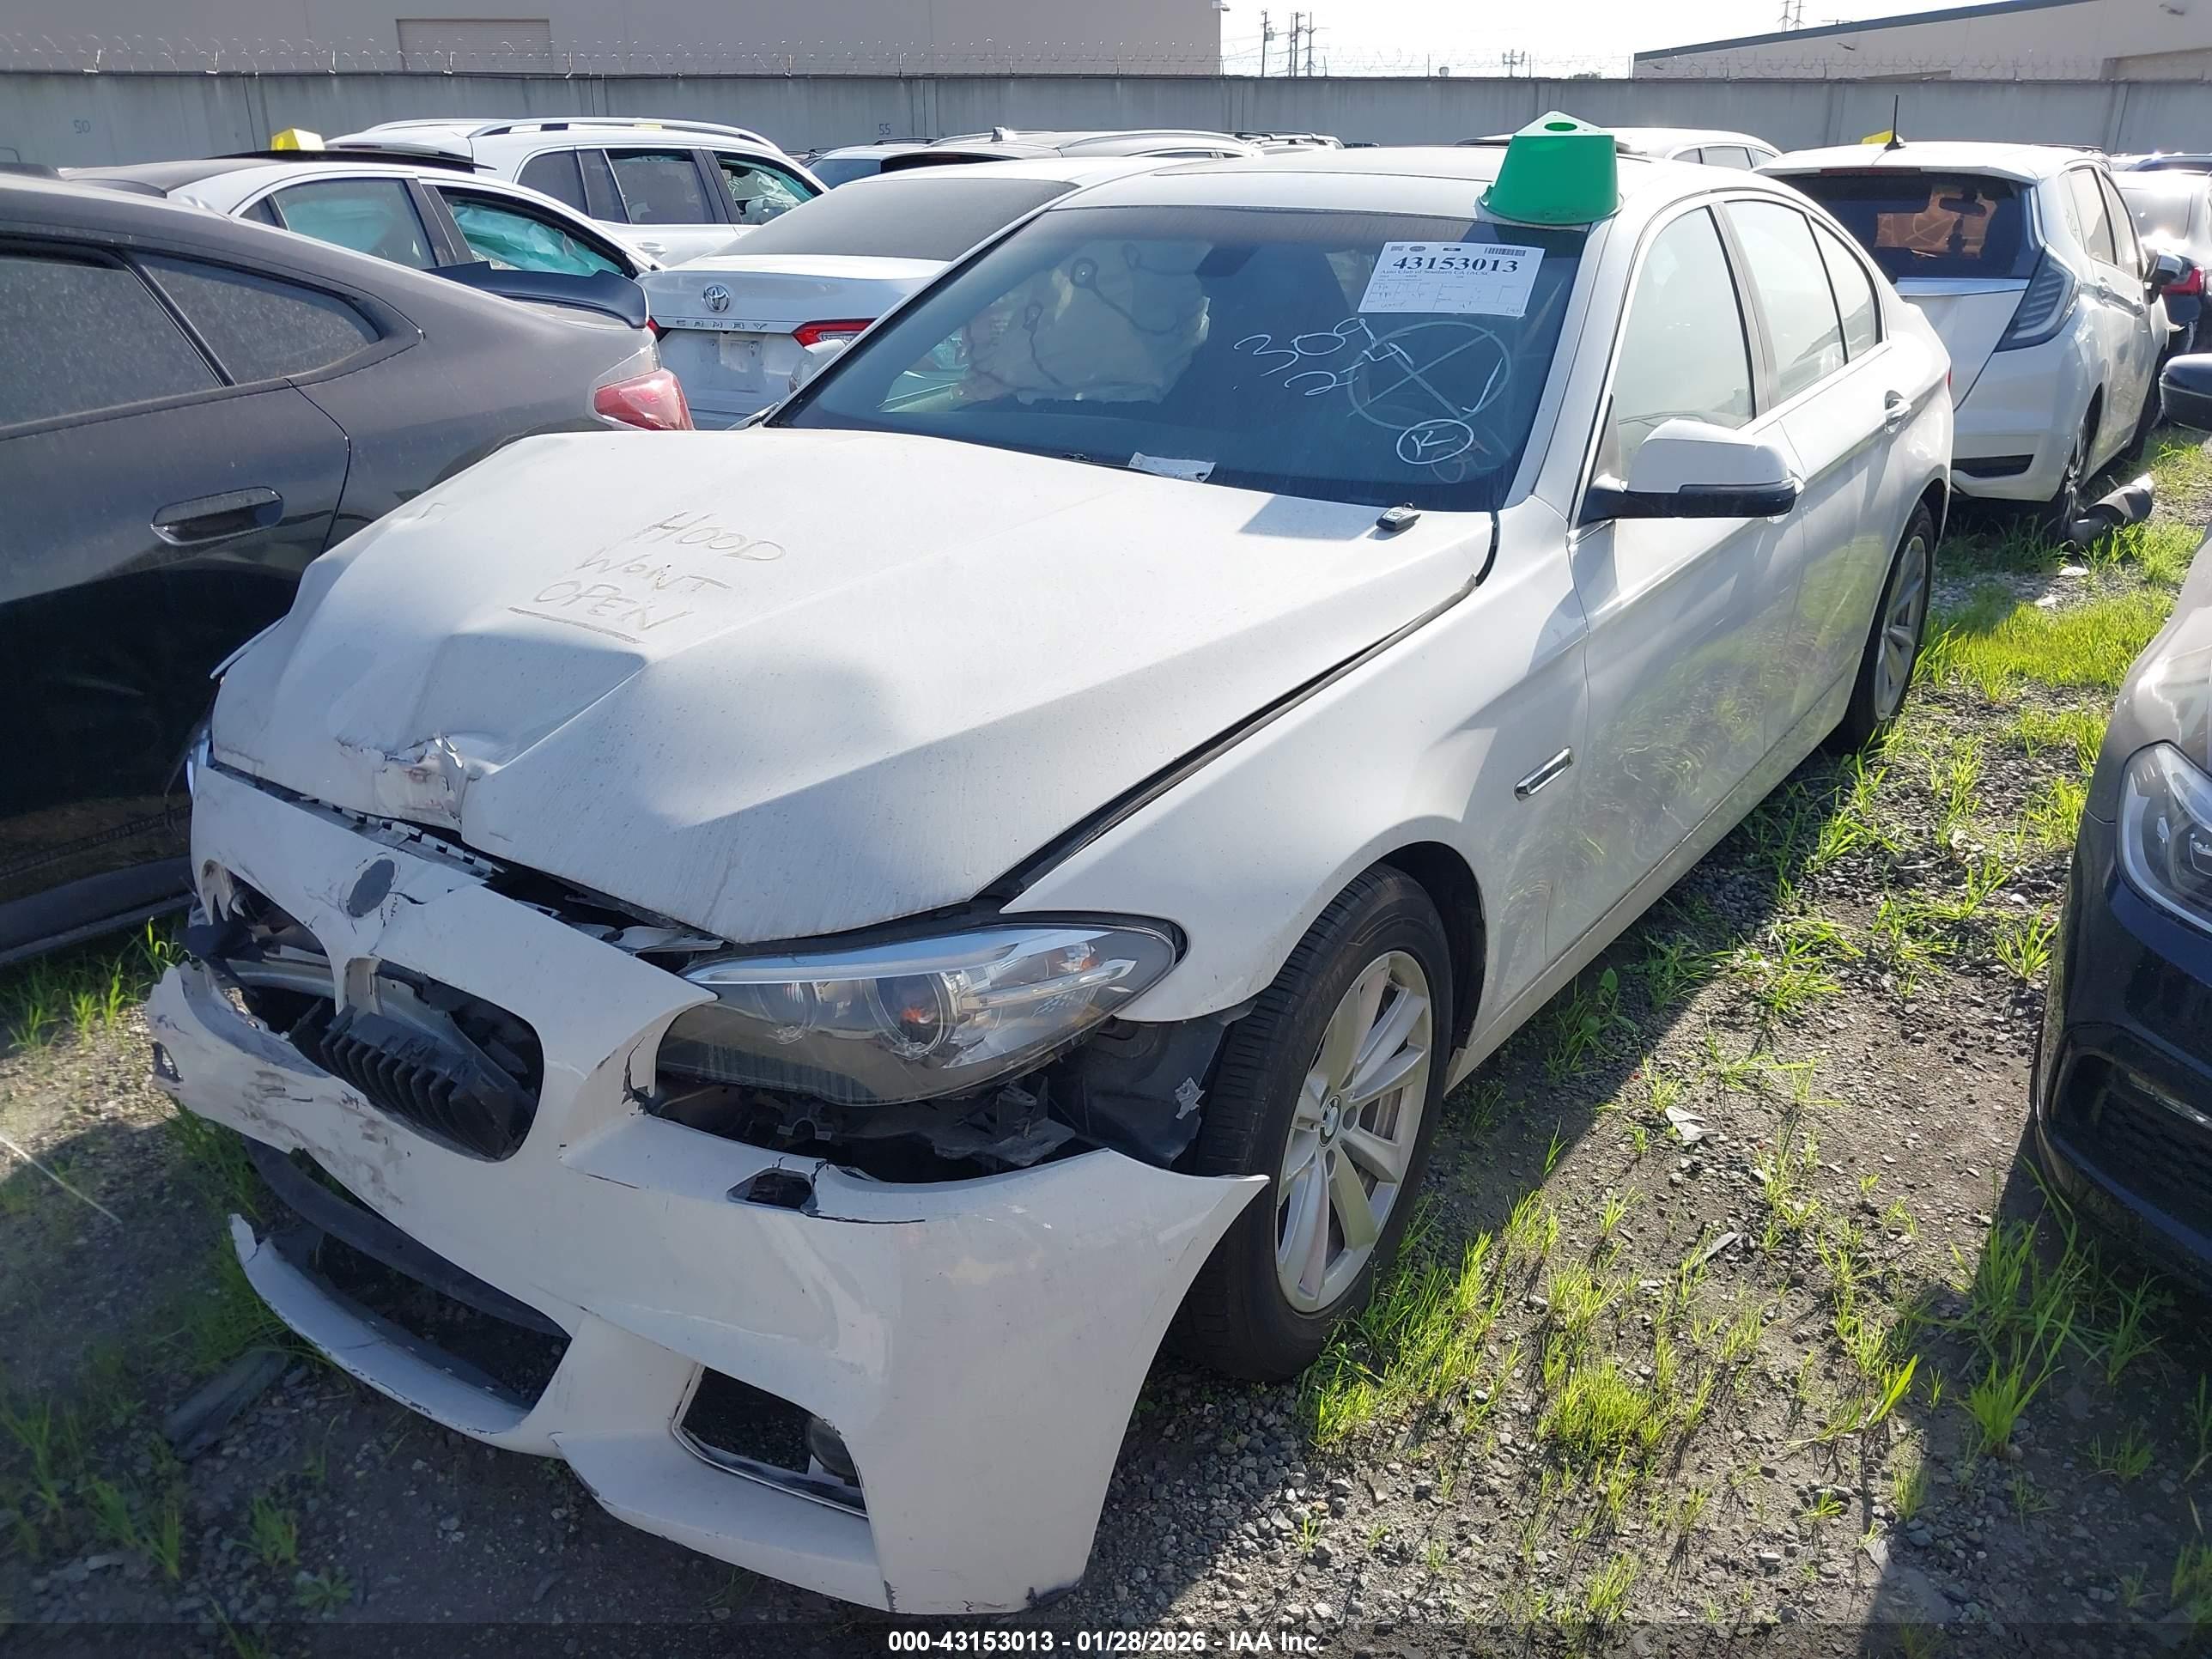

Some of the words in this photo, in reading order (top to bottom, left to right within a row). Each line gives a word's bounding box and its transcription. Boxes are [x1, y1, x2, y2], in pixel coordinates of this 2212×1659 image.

[878, 123, 891, 136] 55
[1392, 256, 1518, 273] 43153013
[676, 319, 768, 331] CAMRY
[631, 510, 787, 562] HOOD
[533, 580, 694, 630] OPEN
